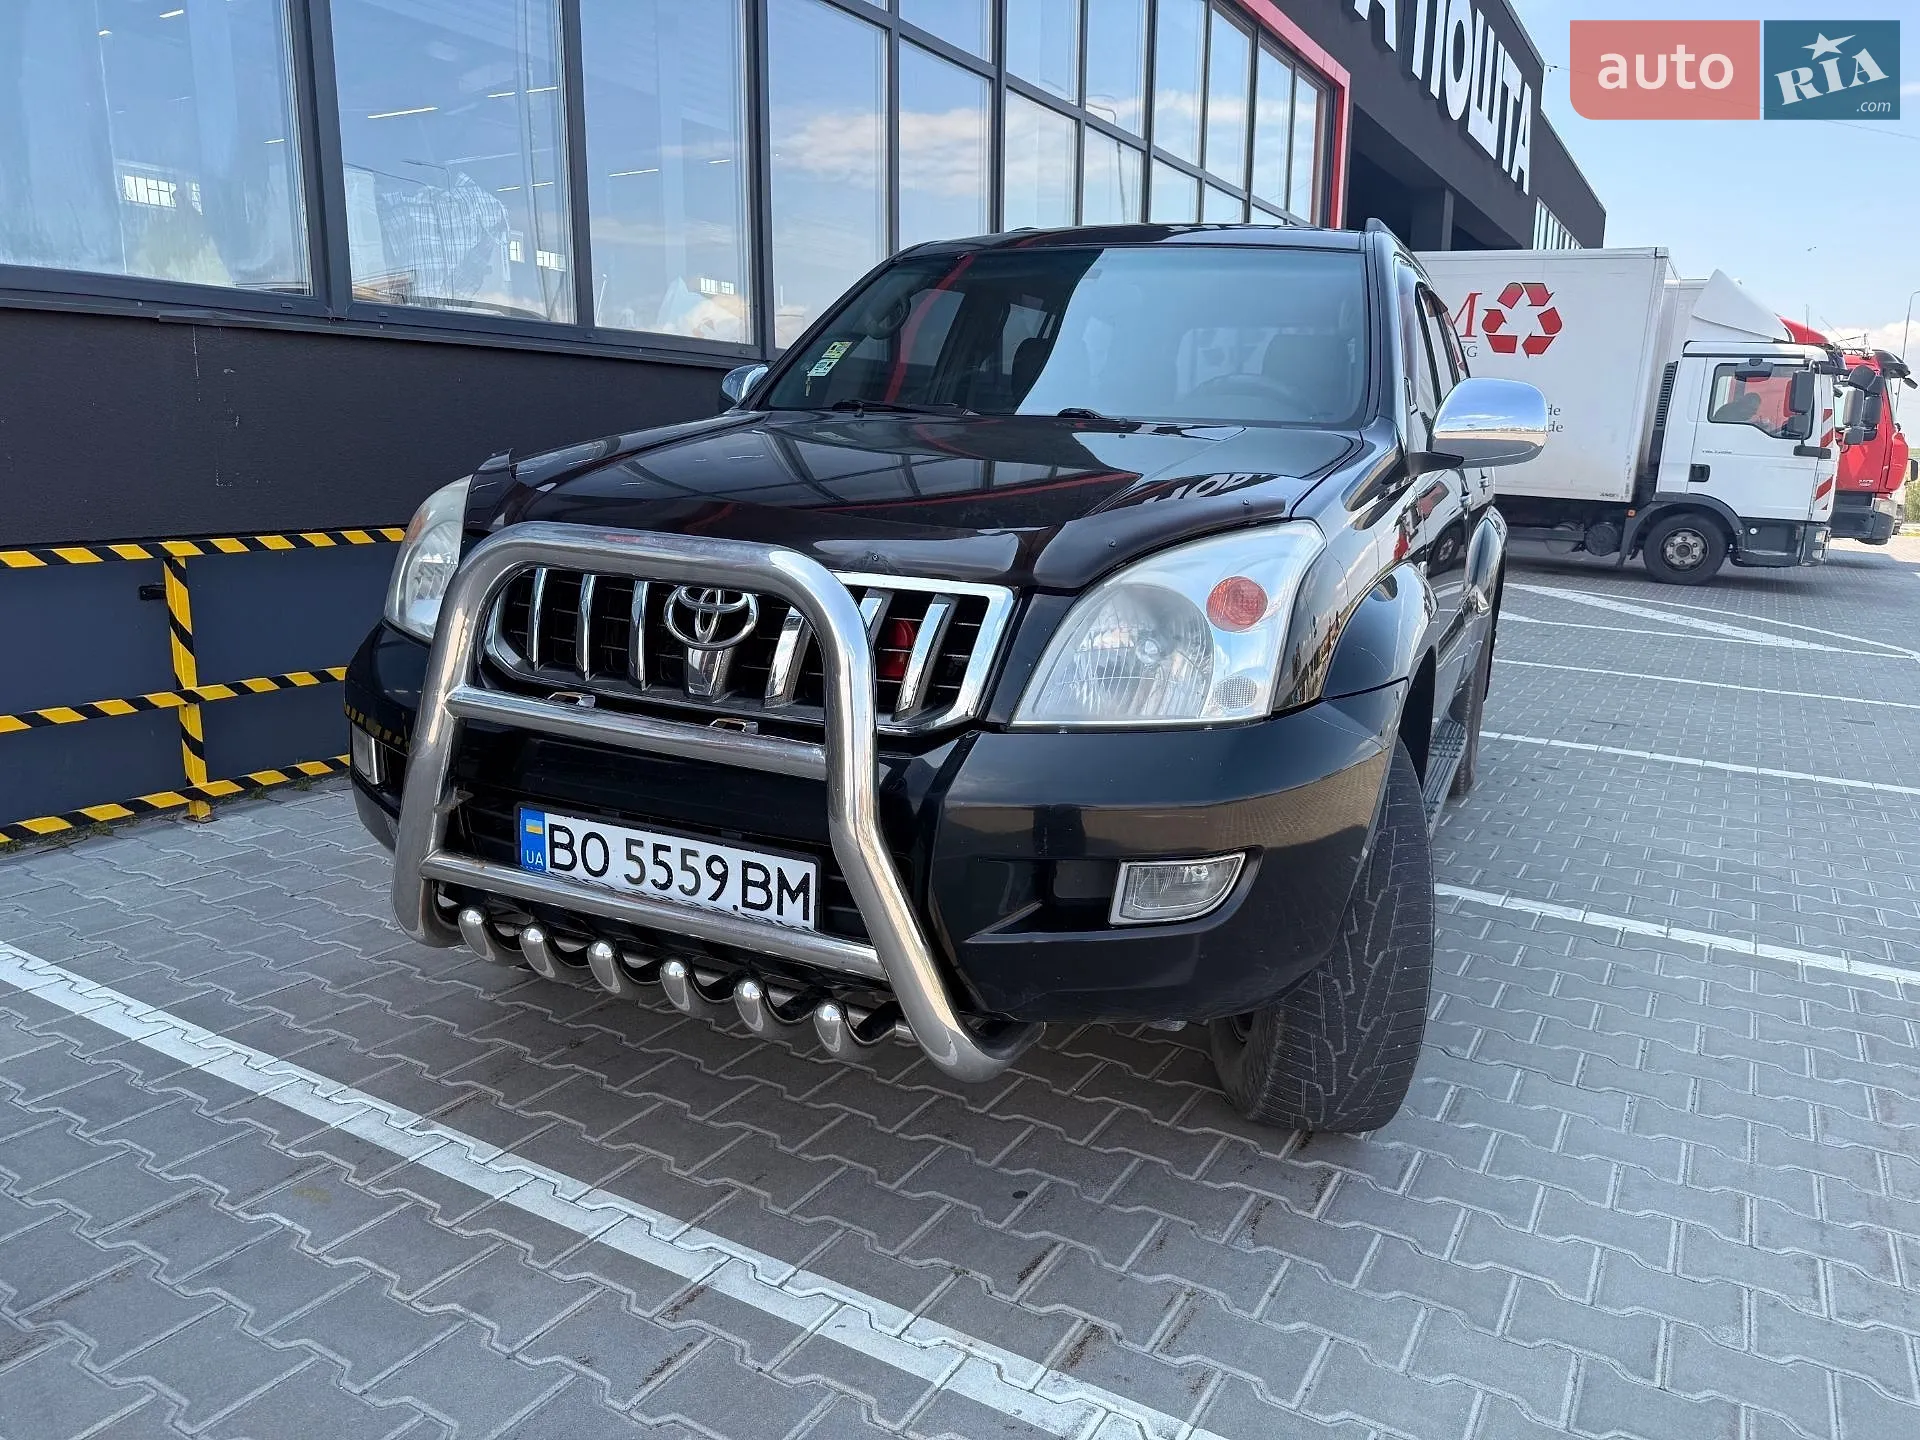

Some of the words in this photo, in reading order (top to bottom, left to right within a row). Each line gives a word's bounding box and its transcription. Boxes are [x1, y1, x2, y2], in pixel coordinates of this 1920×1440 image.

[526, 849, 544, 868] UA
[549, 823, 610, 878] BO
[623, 837, 729, 902] 5559
[741, 859, 811, 921] BM
